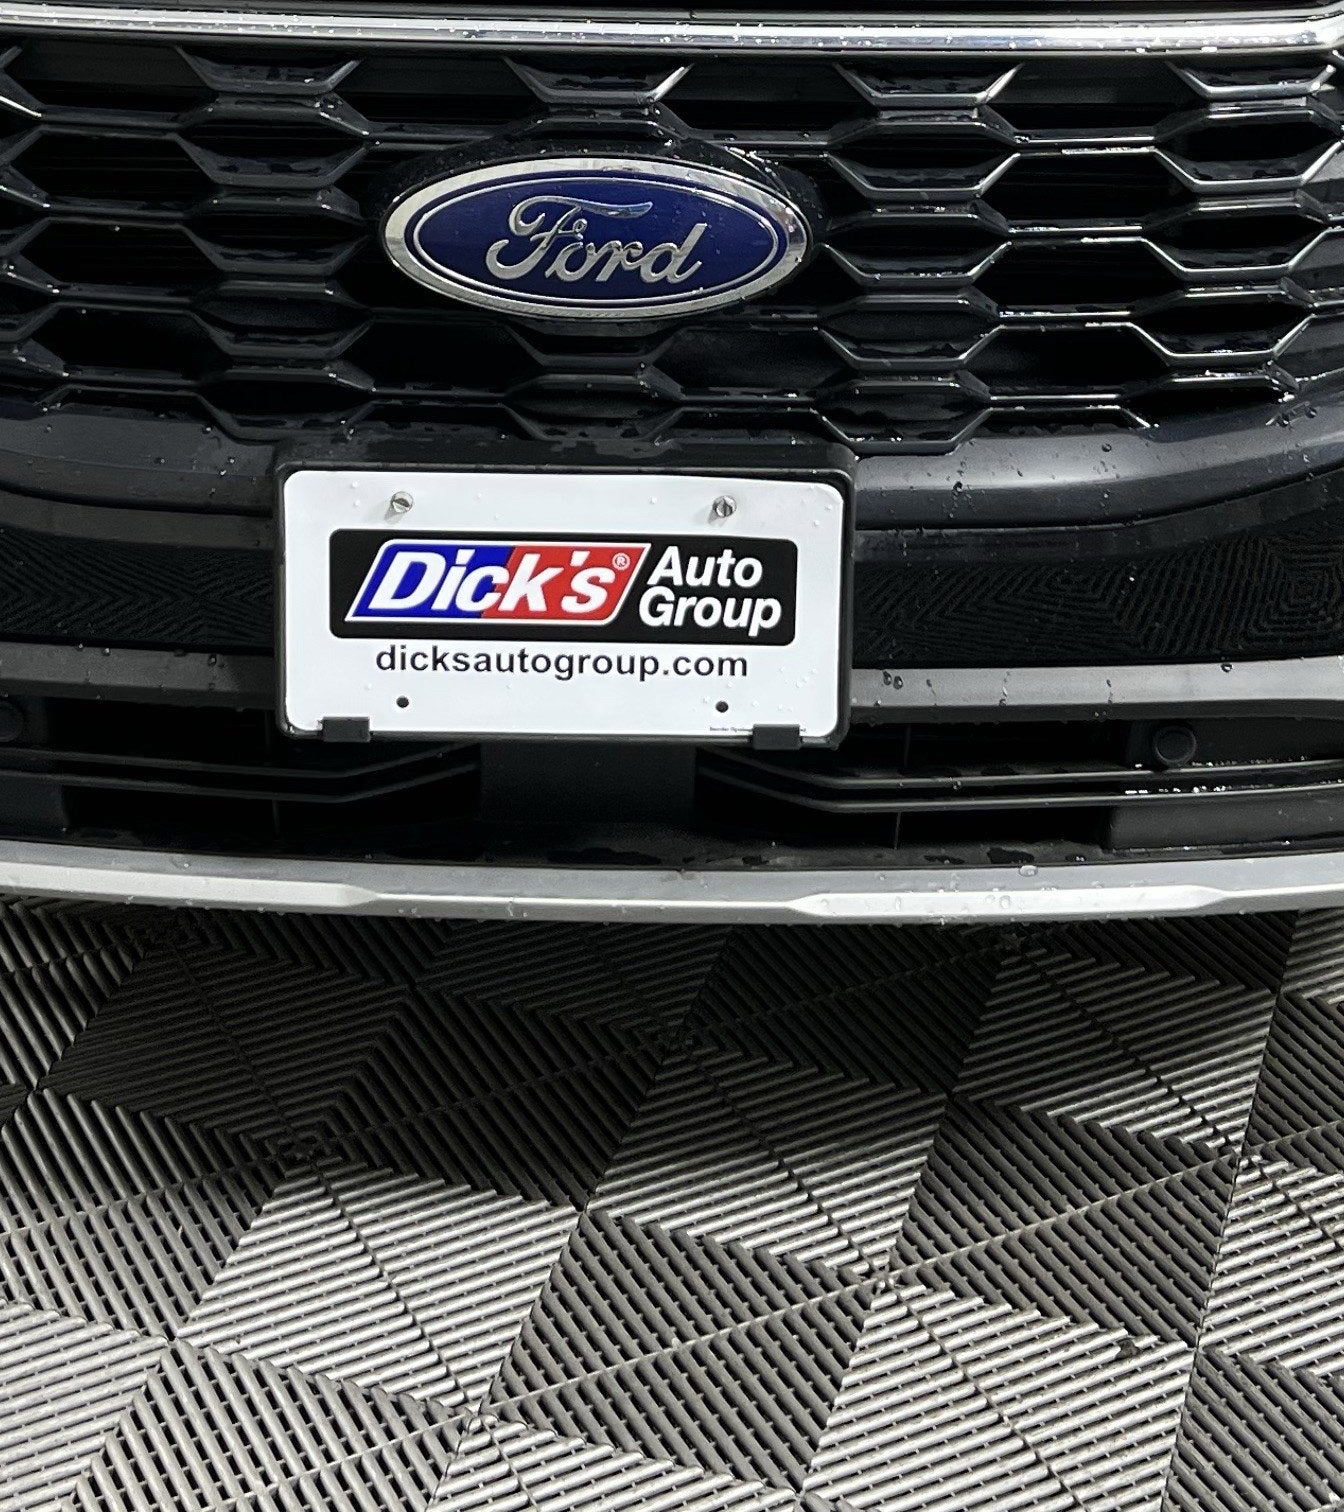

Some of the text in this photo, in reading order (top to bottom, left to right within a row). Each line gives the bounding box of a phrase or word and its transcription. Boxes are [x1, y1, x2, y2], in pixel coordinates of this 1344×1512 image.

[486, 194, 709, 284] Ford
[647, 546, 763, 587] Auto
[638, 587, 782, 637] Group
[375, 644, 748, 681] dicksautogroup.com
